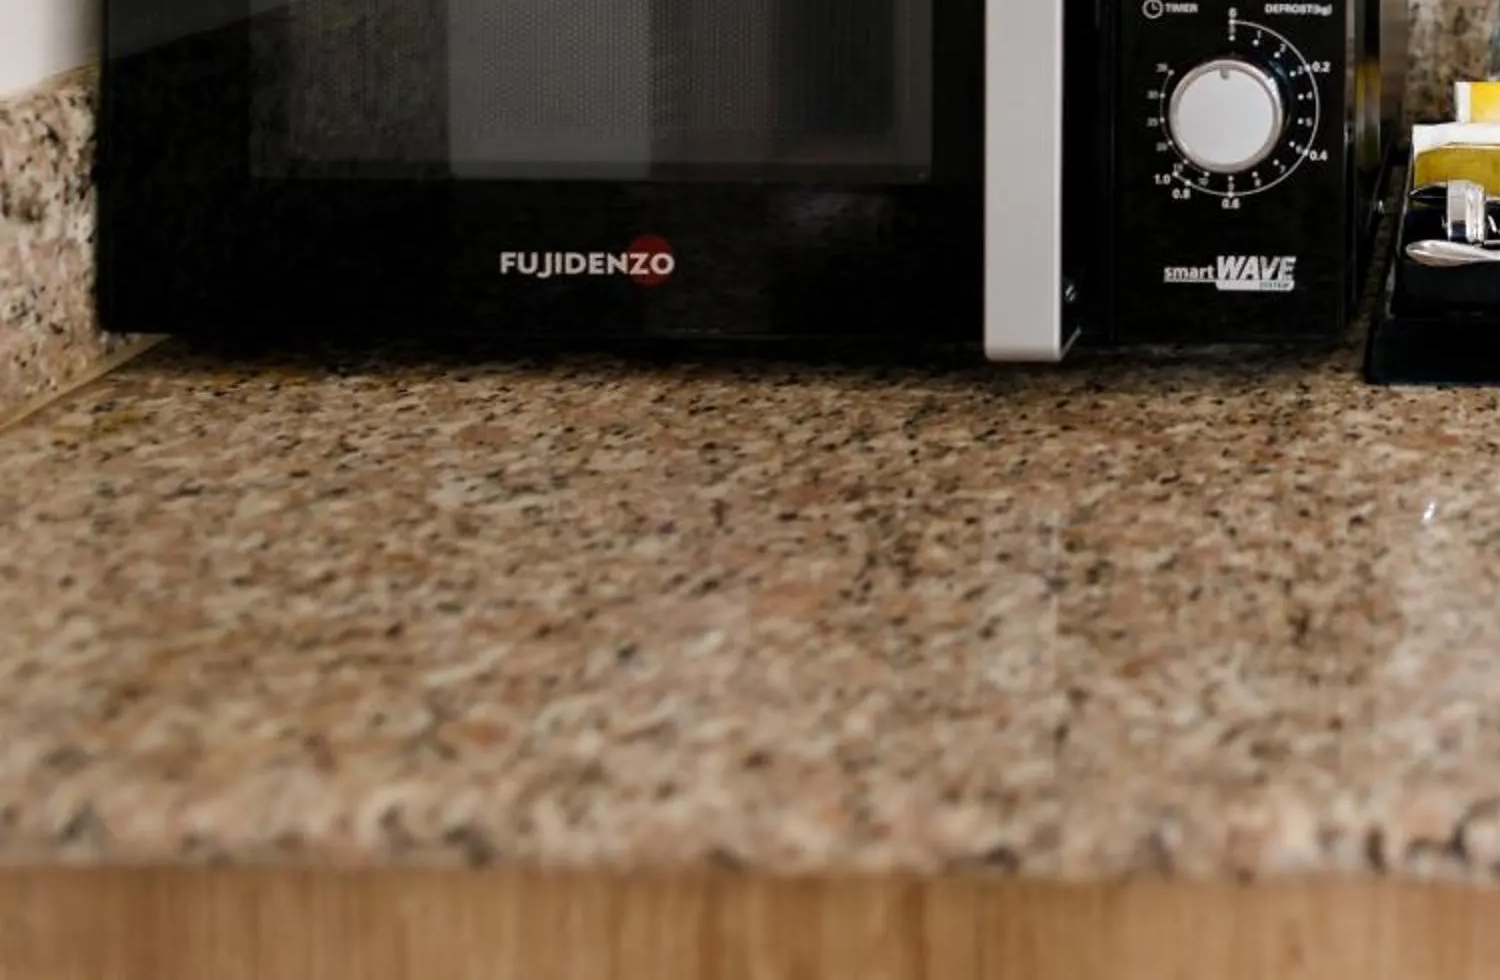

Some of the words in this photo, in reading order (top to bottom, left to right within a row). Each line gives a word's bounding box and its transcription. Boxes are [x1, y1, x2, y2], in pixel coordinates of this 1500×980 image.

[1165, 2, 1200, 14] TIMER
[1312, 61, 1332, 73] 0.2
[1309, 149, 1328, 162] 0.4
[1154, 173, 1171, 185] 1.0
[500, 251, 675, 279] FUJIDENZO
